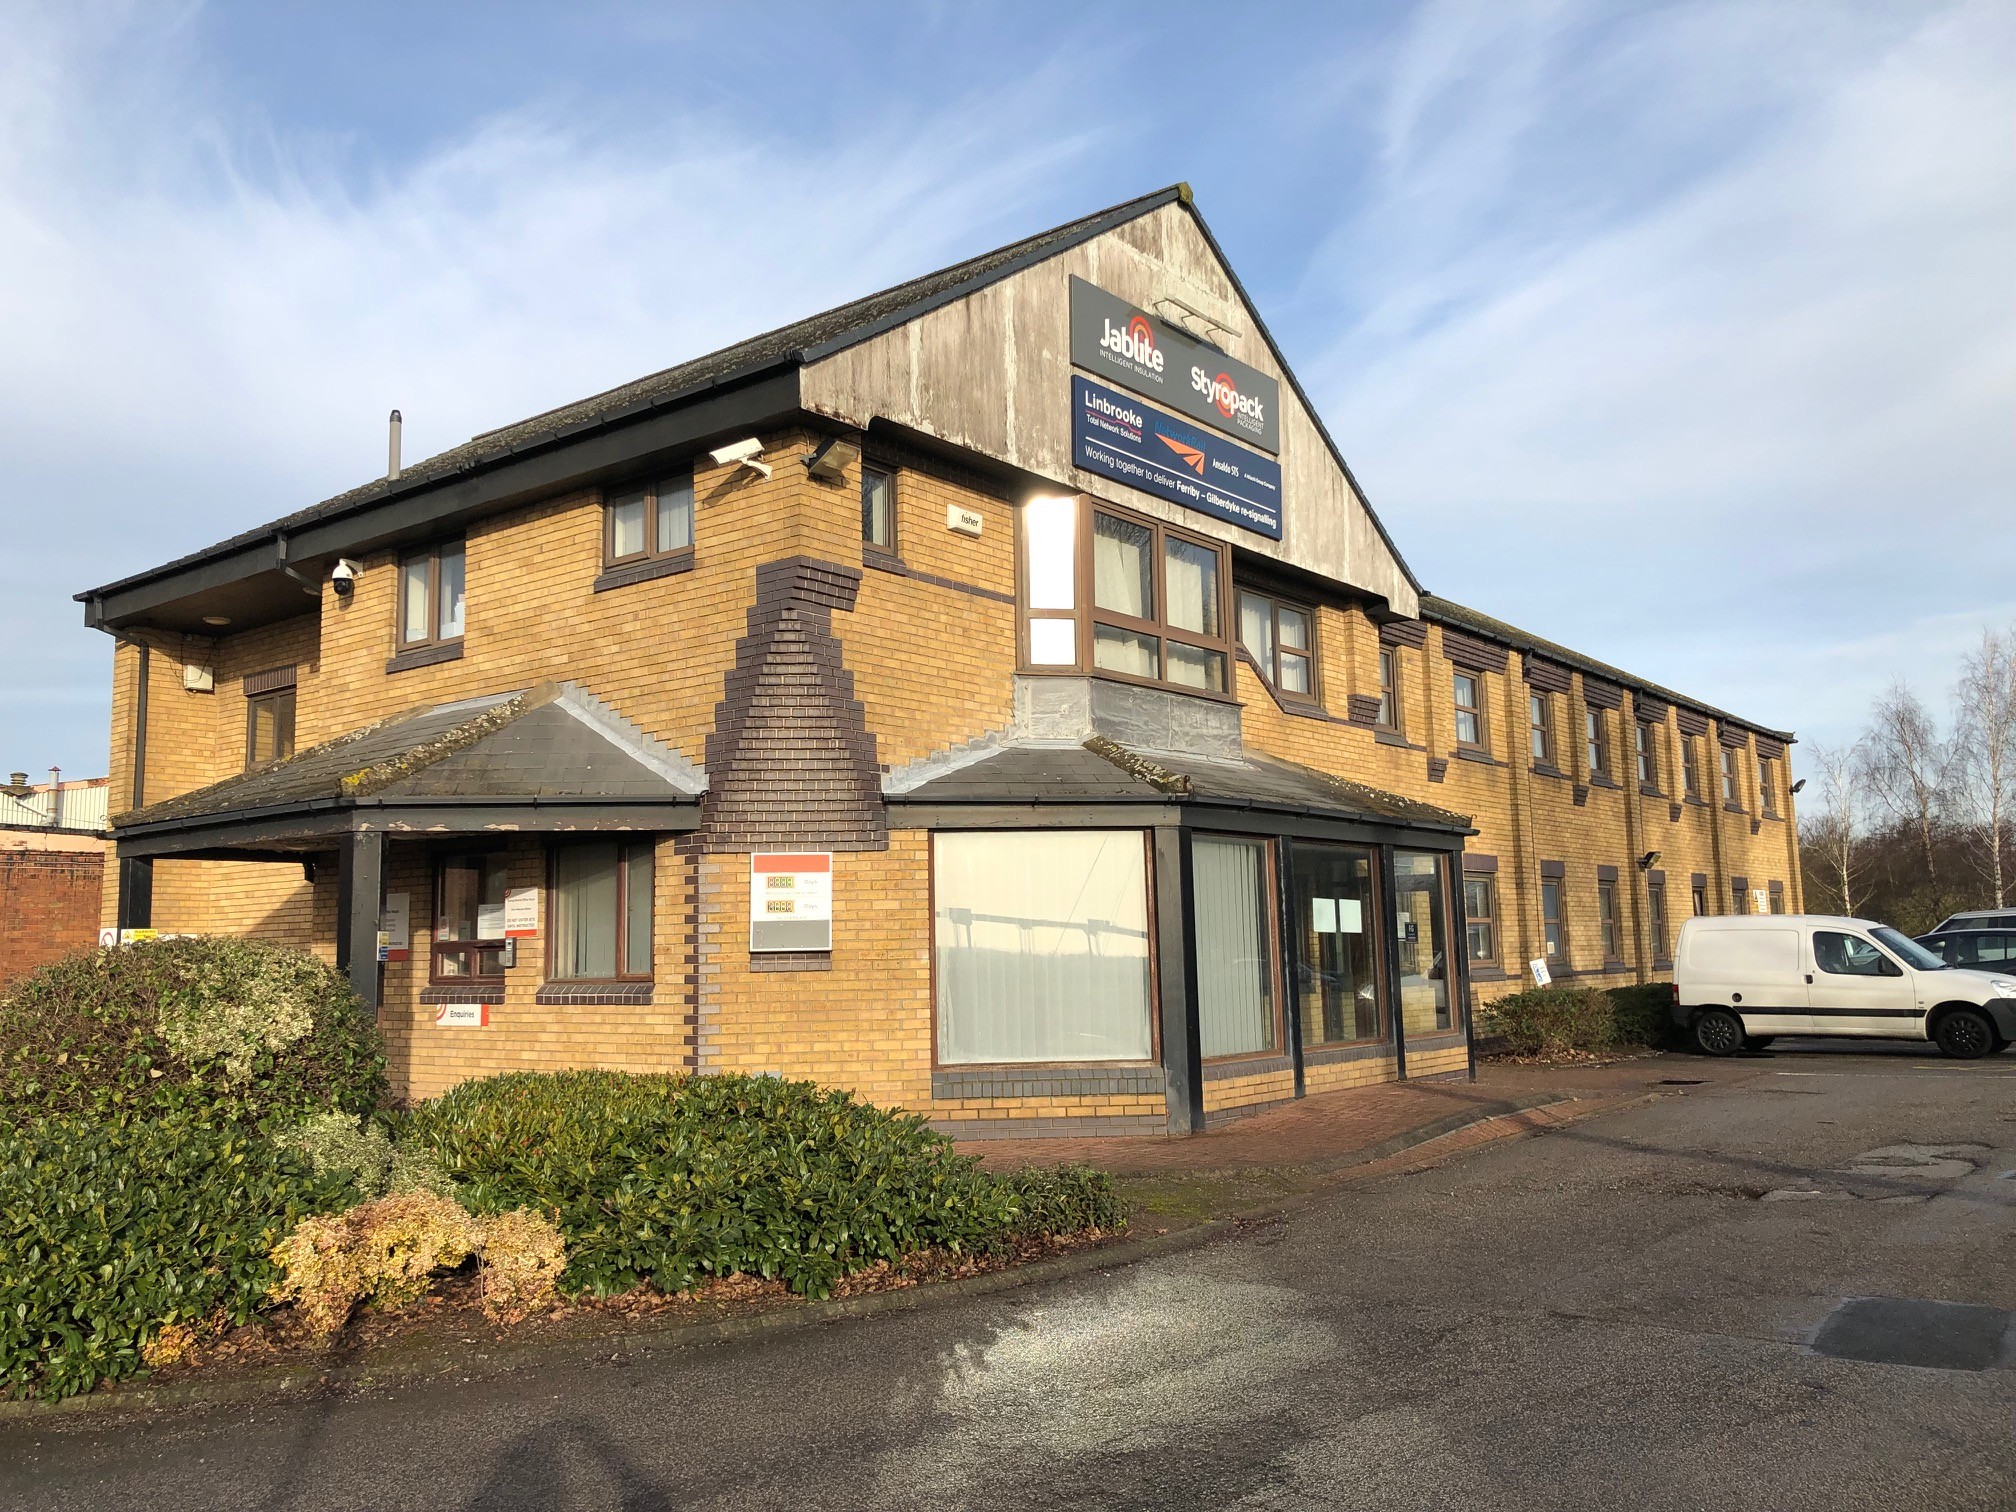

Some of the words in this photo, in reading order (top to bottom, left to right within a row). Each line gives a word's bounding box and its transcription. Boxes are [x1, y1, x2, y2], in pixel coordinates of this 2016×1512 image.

[1099, 318, 1164, 373] Jablite
[1099, 349, 1133, 370] INTELLIGENT
[1134, 365, 1164, 384] INSULATION
[1085, 390, 1143, 428] Linbrooke
[1191, 366, 1264, 421] Styropack
[1086, 413, 1099, 425] Total
[1099, 418, 1120, 434] Network
[1120, 426, 1142, 443] Solutions
[1237, 411, 1264, 429] INTELLIGENT
[1237, 418, 1262, 435] PACKAGING
[1085, 445, 1115, 468] Working
[1115, 455, 1144, 478] together
[1145, 466, 1152, 480] to
[1153, 469, 1176, 489] deliver
[1176, 480, 1200, 501] Ferriby
[1206, 492, 1240, 514] Gilberdyke
[1240, 506, 1277, 530] re-signalling
[961, 514, 979, 527] fisher
[450, 1010, 474, 1018] Enquiries
